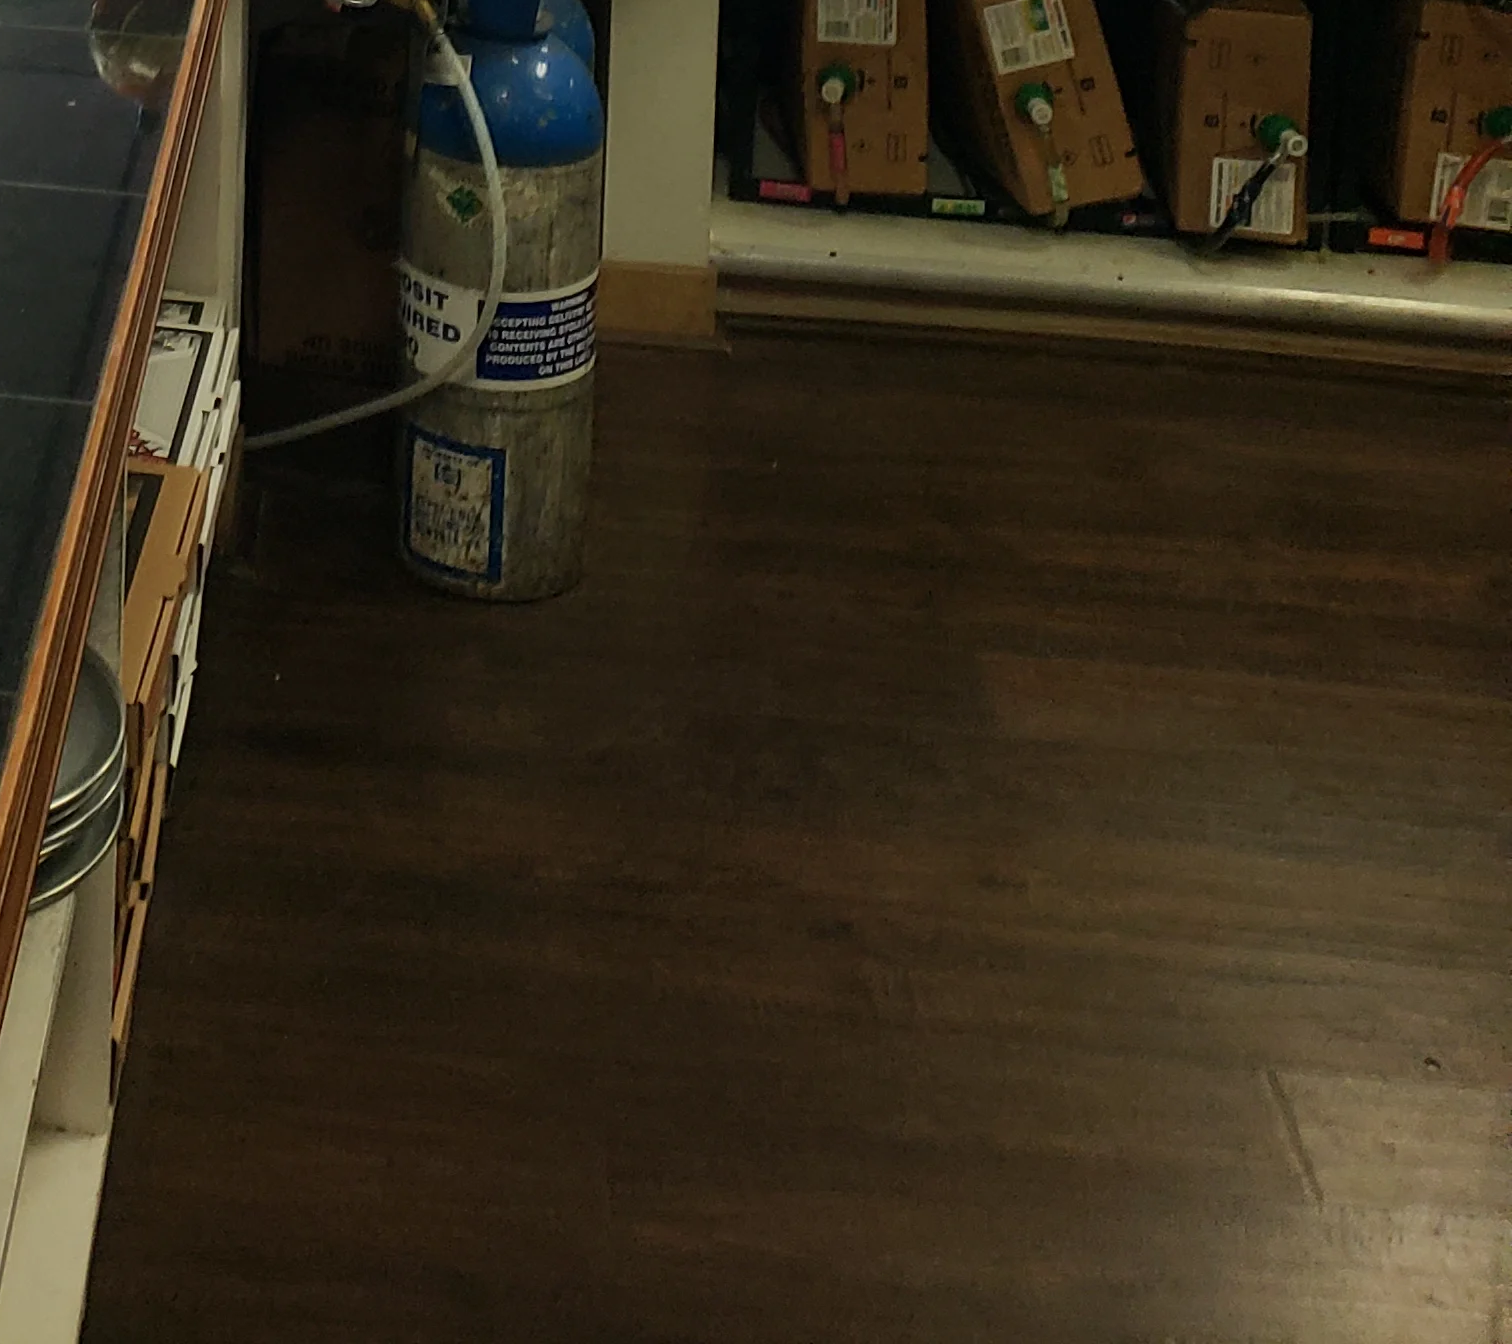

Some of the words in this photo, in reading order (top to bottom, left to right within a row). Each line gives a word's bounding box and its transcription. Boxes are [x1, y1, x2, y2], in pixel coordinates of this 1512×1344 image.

[493, 315, 546, 329] CCEPTING
[501, 326, 556, 341] RECEIVING
[489, 341, 546, 353] CONTENTS
[485, 354, 543, 366] PRODUCED
[546, 352, 559, 363] BY
[538, 364, 553, 376] ON
